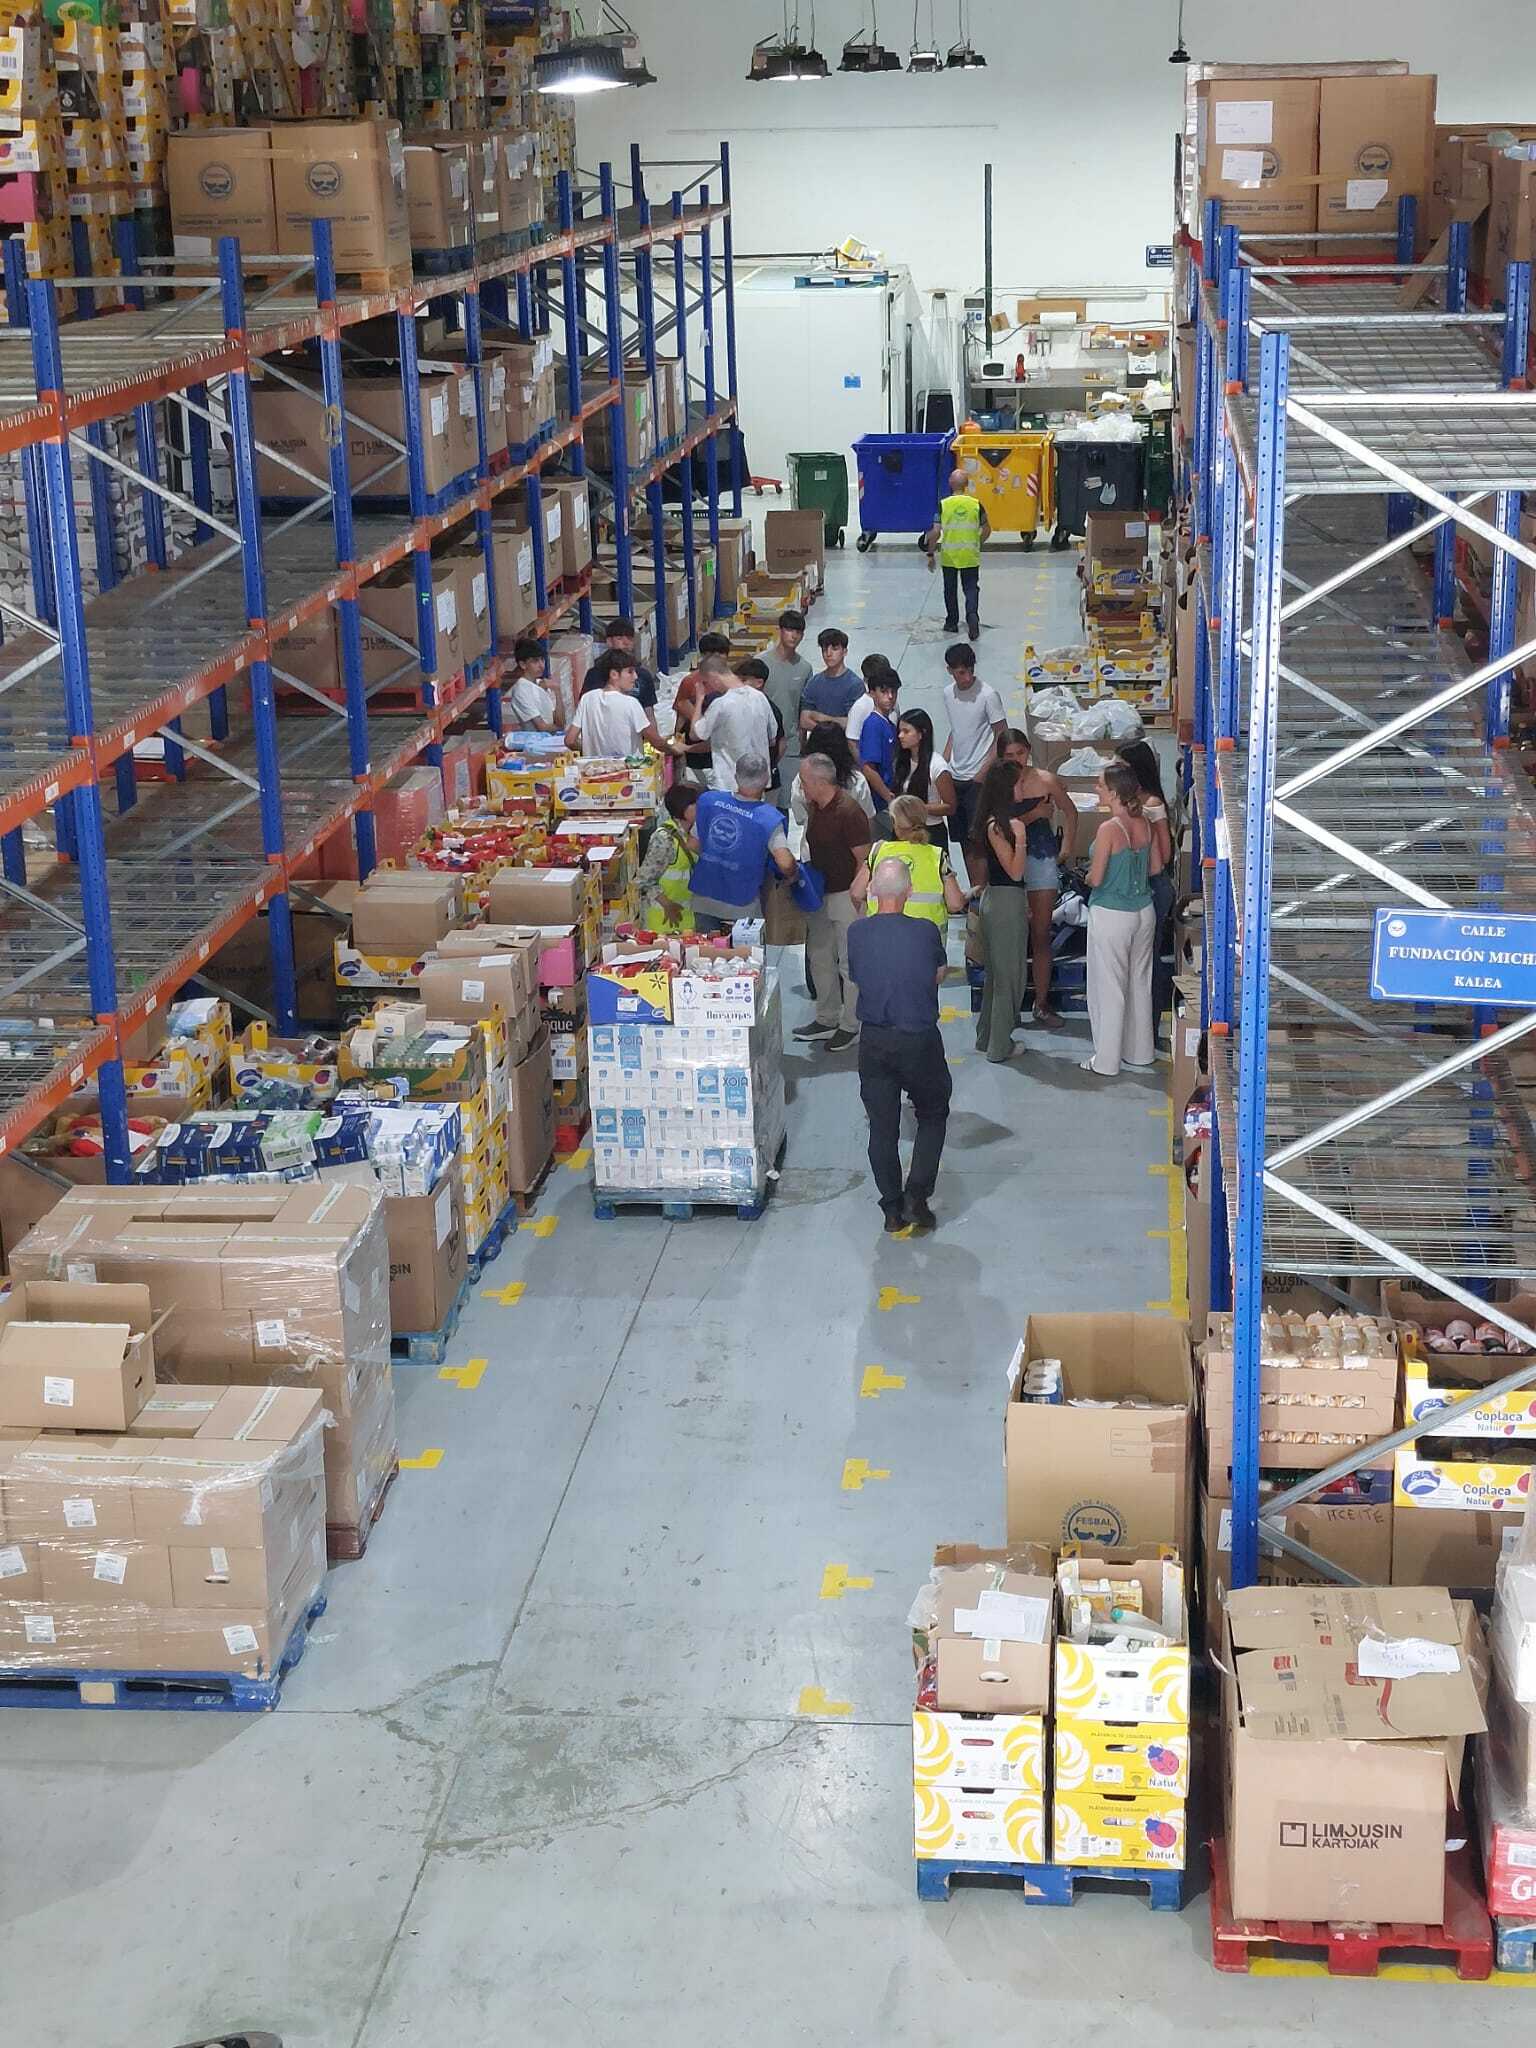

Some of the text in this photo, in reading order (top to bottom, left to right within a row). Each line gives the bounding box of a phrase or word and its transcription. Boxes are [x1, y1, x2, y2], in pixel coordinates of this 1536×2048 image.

[1461, 925, 1506, 938] CALLE
[1388, 946, 1536, 966] FUNDACIÓN MICH
[1454, 975, 1503, 989] KALEA
[1474, 1410, 1523, 1425] Coplaca
[1463, 1483, 1511, 1497] Coplaca
[1466, 1496, 1491, 1506] Natur
[1075, 1516, 1112, 1527] FESBAL
[1149, 1778, 1177, 1788] Natur
[1312, 1823, 1403, 1839] LIMOUSIN
[1312, 1838, 1379, 1849] KARTOIAK
[1146, 1851, 1176, 1860] Natur
[1511, 1874, 1536, 1901] G
